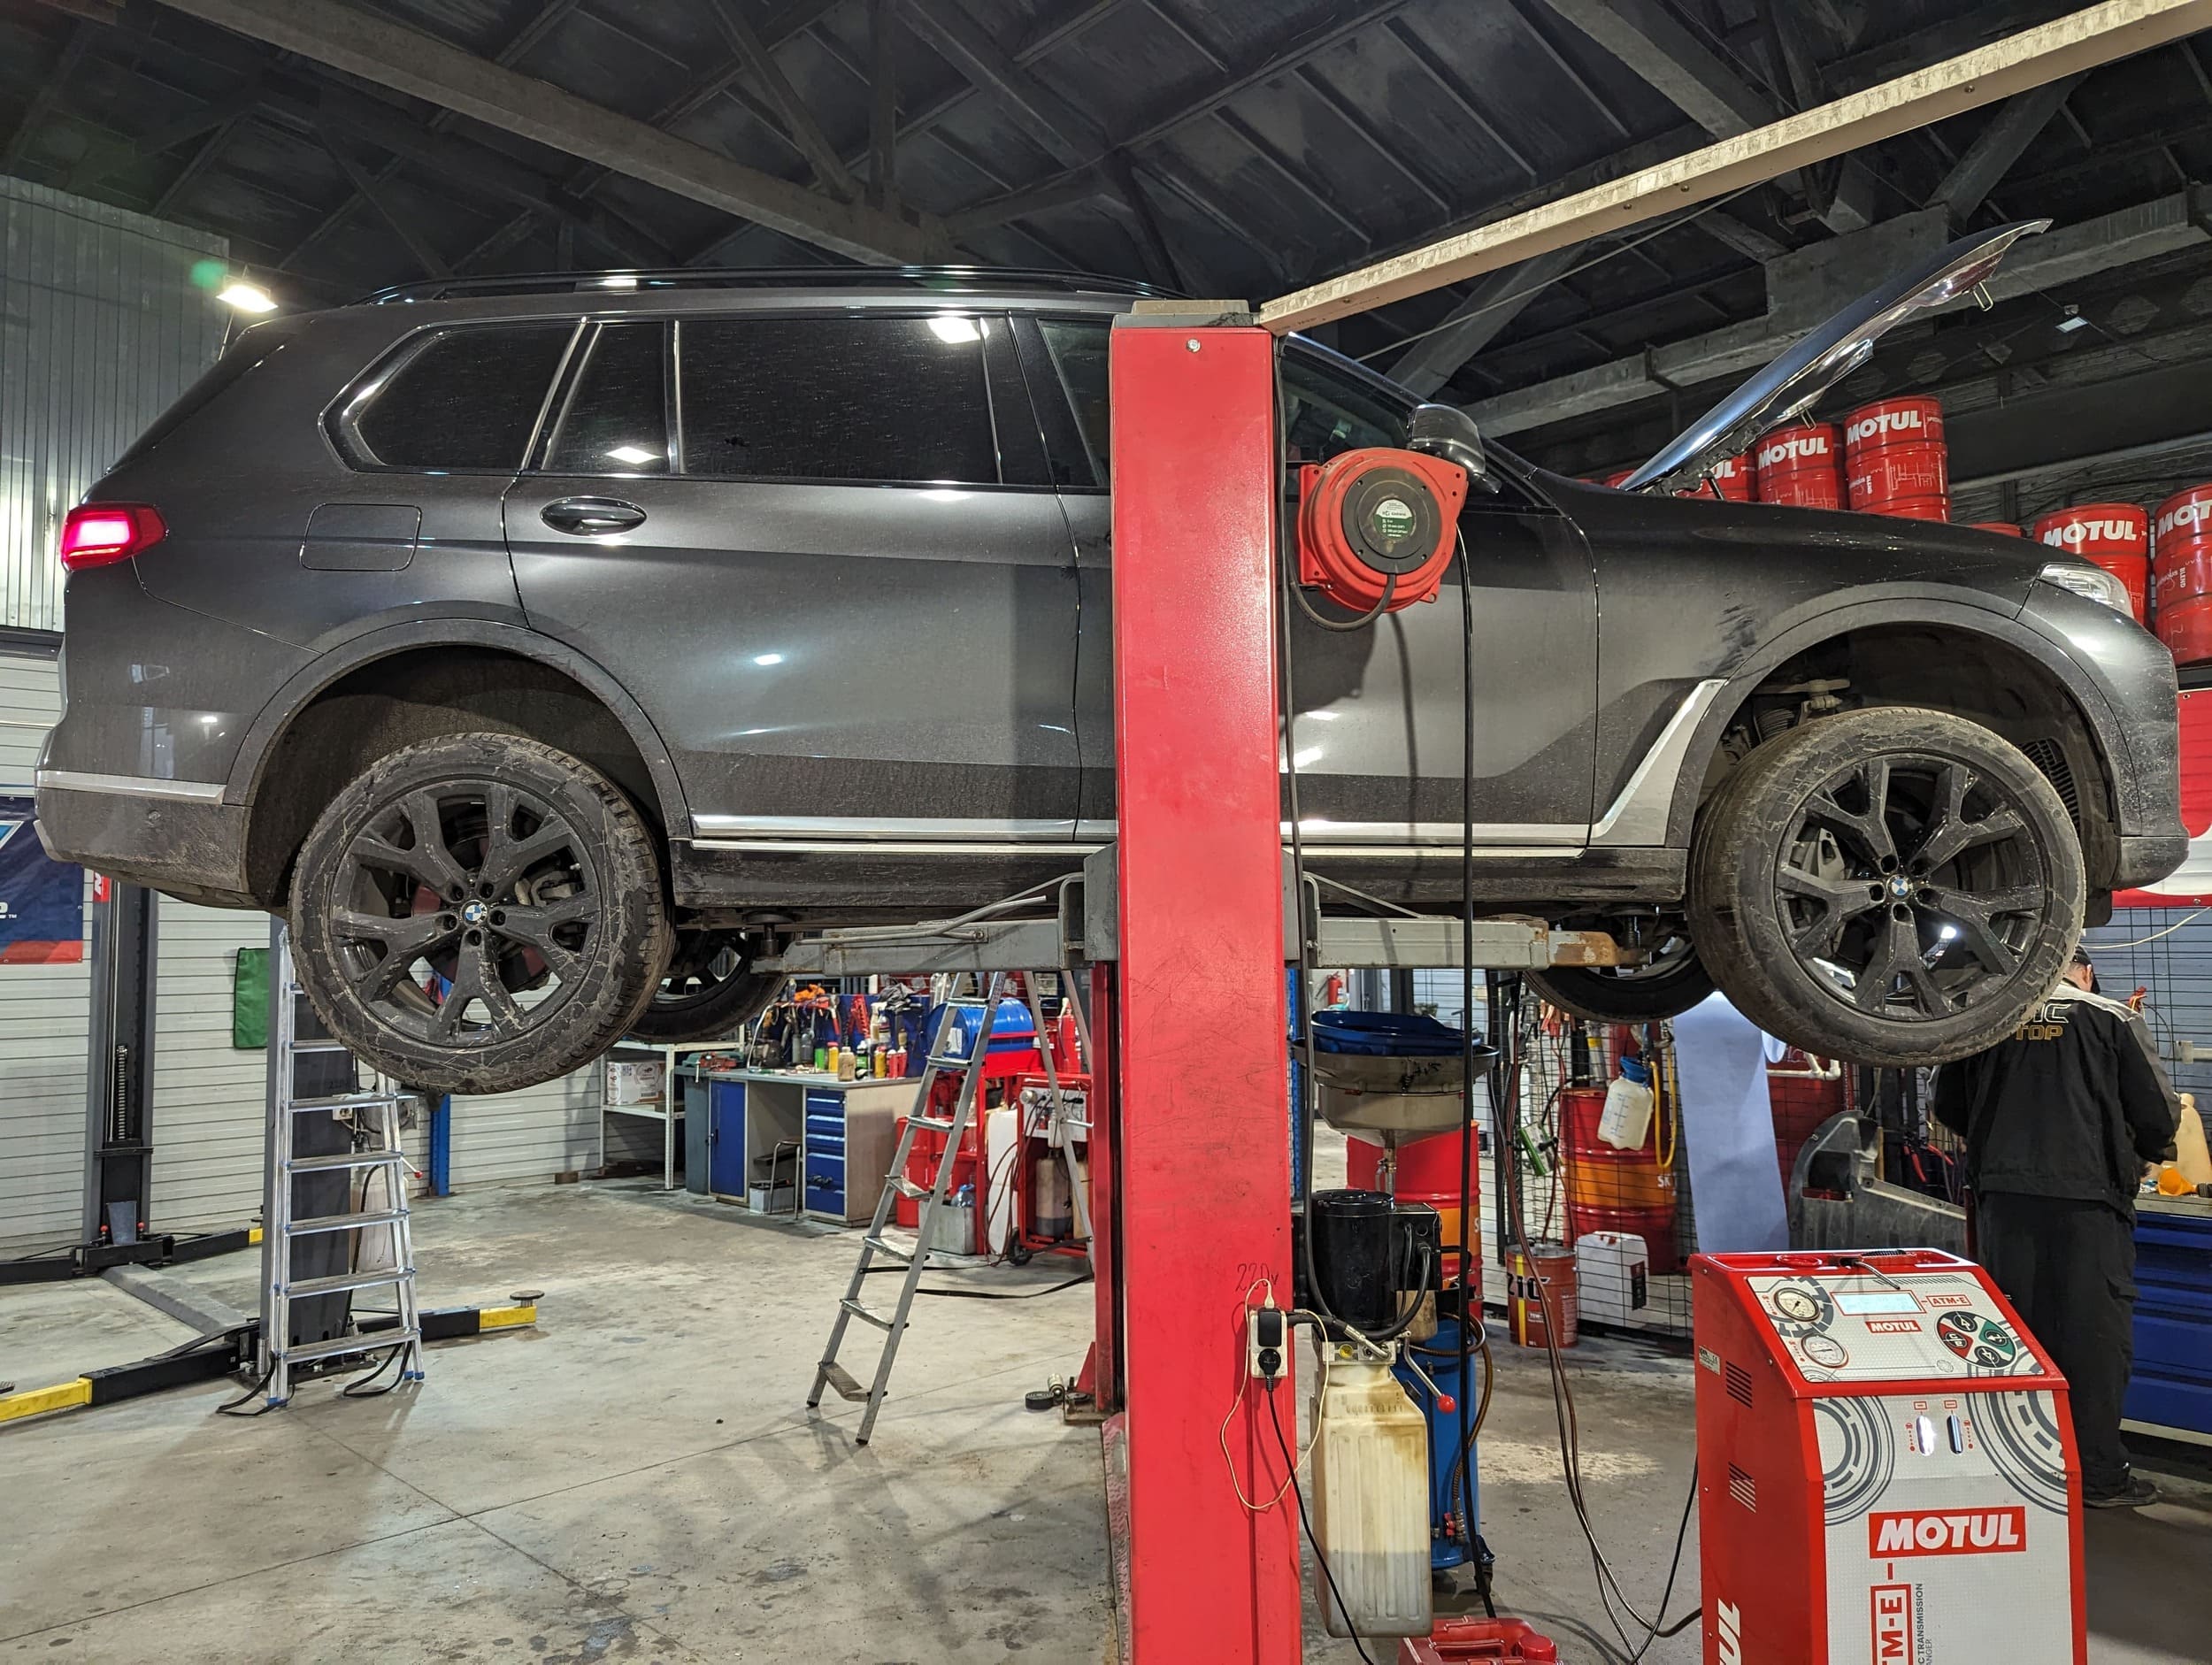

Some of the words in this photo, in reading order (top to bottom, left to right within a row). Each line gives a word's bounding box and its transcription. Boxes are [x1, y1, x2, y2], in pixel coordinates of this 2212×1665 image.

[1847, 410, 1923, 445] MOTUL
[1709, 459, 1736, 480] UL
[1758, 437, 1828, 470] MOTUL
[2043, 520, 2137, 548] MOTUL
[2033, 1003, 2072, 1024] IC
[2016, 1025, 2063, 1040] TOP
[1870, 1321, 1919, 1331] MOTUL
[1877, 1514, 2019, 1551] MOTUL
[1717, 1598, 1741, 1665] UL
[1880, 1597, 1904, 1665] M-E
[1916, 1584, 1925, 1656] TRANSMISSION
